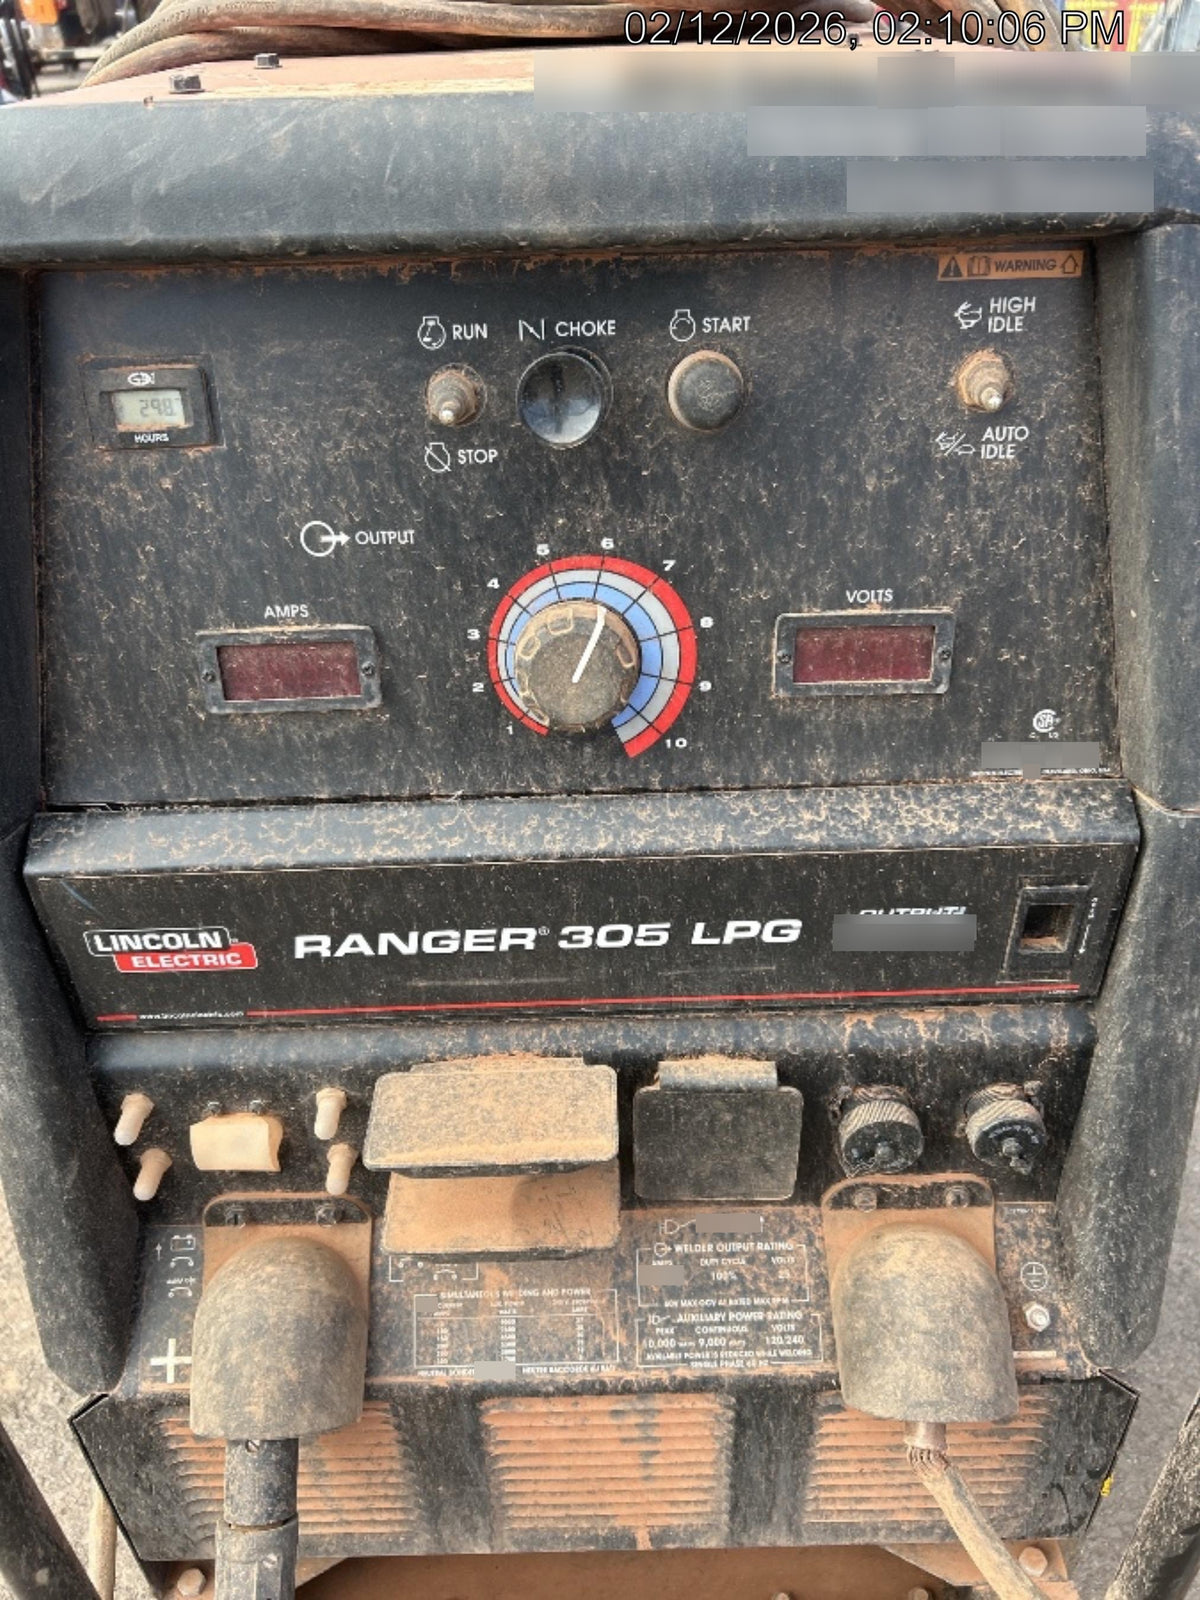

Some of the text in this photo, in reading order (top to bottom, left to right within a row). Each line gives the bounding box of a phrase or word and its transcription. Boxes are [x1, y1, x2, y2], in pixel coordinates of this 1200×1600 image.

[994, 258, 1057, 271] WARNING
[989, 296, 1037, 314] HIGH
[555, 319, 616, 338] CHOKE
[702, 316, 751, 333] START
[987, 316, 1024, 333] IDLE
[452, 323, 488, 341] RUN
[134, 433, 170, 443] HOURS
[981, 426, 1029, 442] AUTO
[457, 448, 498, 464] STOP
[980, 444, 1016, 460] IDLE
[355, 529, 415, 545] OUTPUT
[601, 538, 614, 549] 6
[536, 544, 550, 556] 5
[662, 559, 676, 571] 7
[487, 578, 500, 589] 4
[845, 588, 894, 604] VOLTS
[264, 604, 309, 618] AMPS
[700, 617, 714, 628] 8
[467, 629, 480, 640] 3
[472, 683, 484, 693] 2
[699, 681, 712, 692] 9
[506, 724, 513, 735] 1
[665, 738, 688, 748] 10
[558, 922, 671, 949] 305
[691, 919, 803, 945] LPG
[93, 930, 223, 952] LINCOLN
[131, 952, 243, 968] ELECTRIC
[674, 1241, 794, 1253] WELDER OUTPUT RATING
[676, 1312, 726, 1323] AUXILIARY
[728, 1311, 765, 1321] POWER
